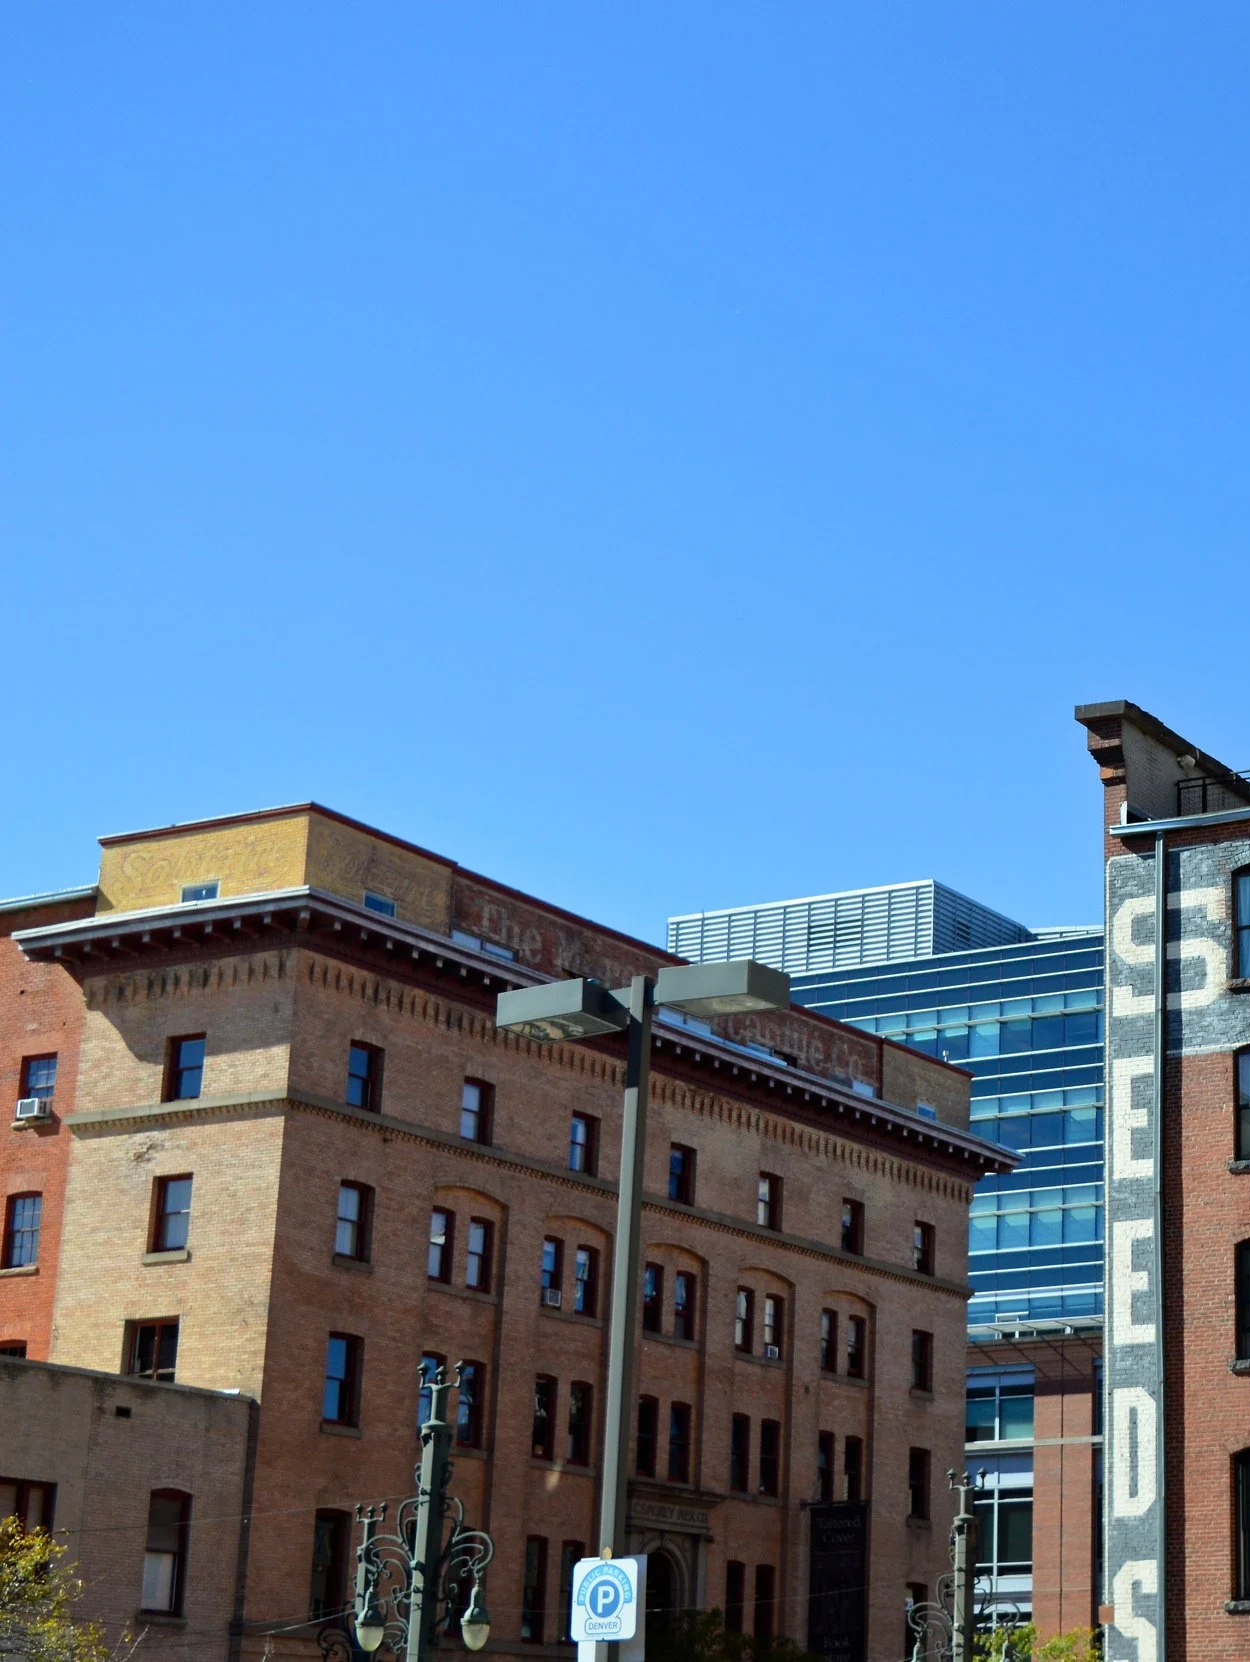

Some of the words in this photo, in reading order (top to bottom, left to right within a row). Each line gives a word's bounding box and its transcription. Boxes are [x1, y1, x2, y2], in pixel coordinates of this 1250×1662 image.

[815, 1515, 861, 1529] Tattered
[821, 1531, 857, 1545] Cover
[579, 1568, 602, 1600] PUBLIC
[603, 1566, 630, 1599] PARKING
[597, 1585, 615, 1614] P
[588, 1621, 618, 1631] DENVER
[823, 1636, 852, 1649] Book
